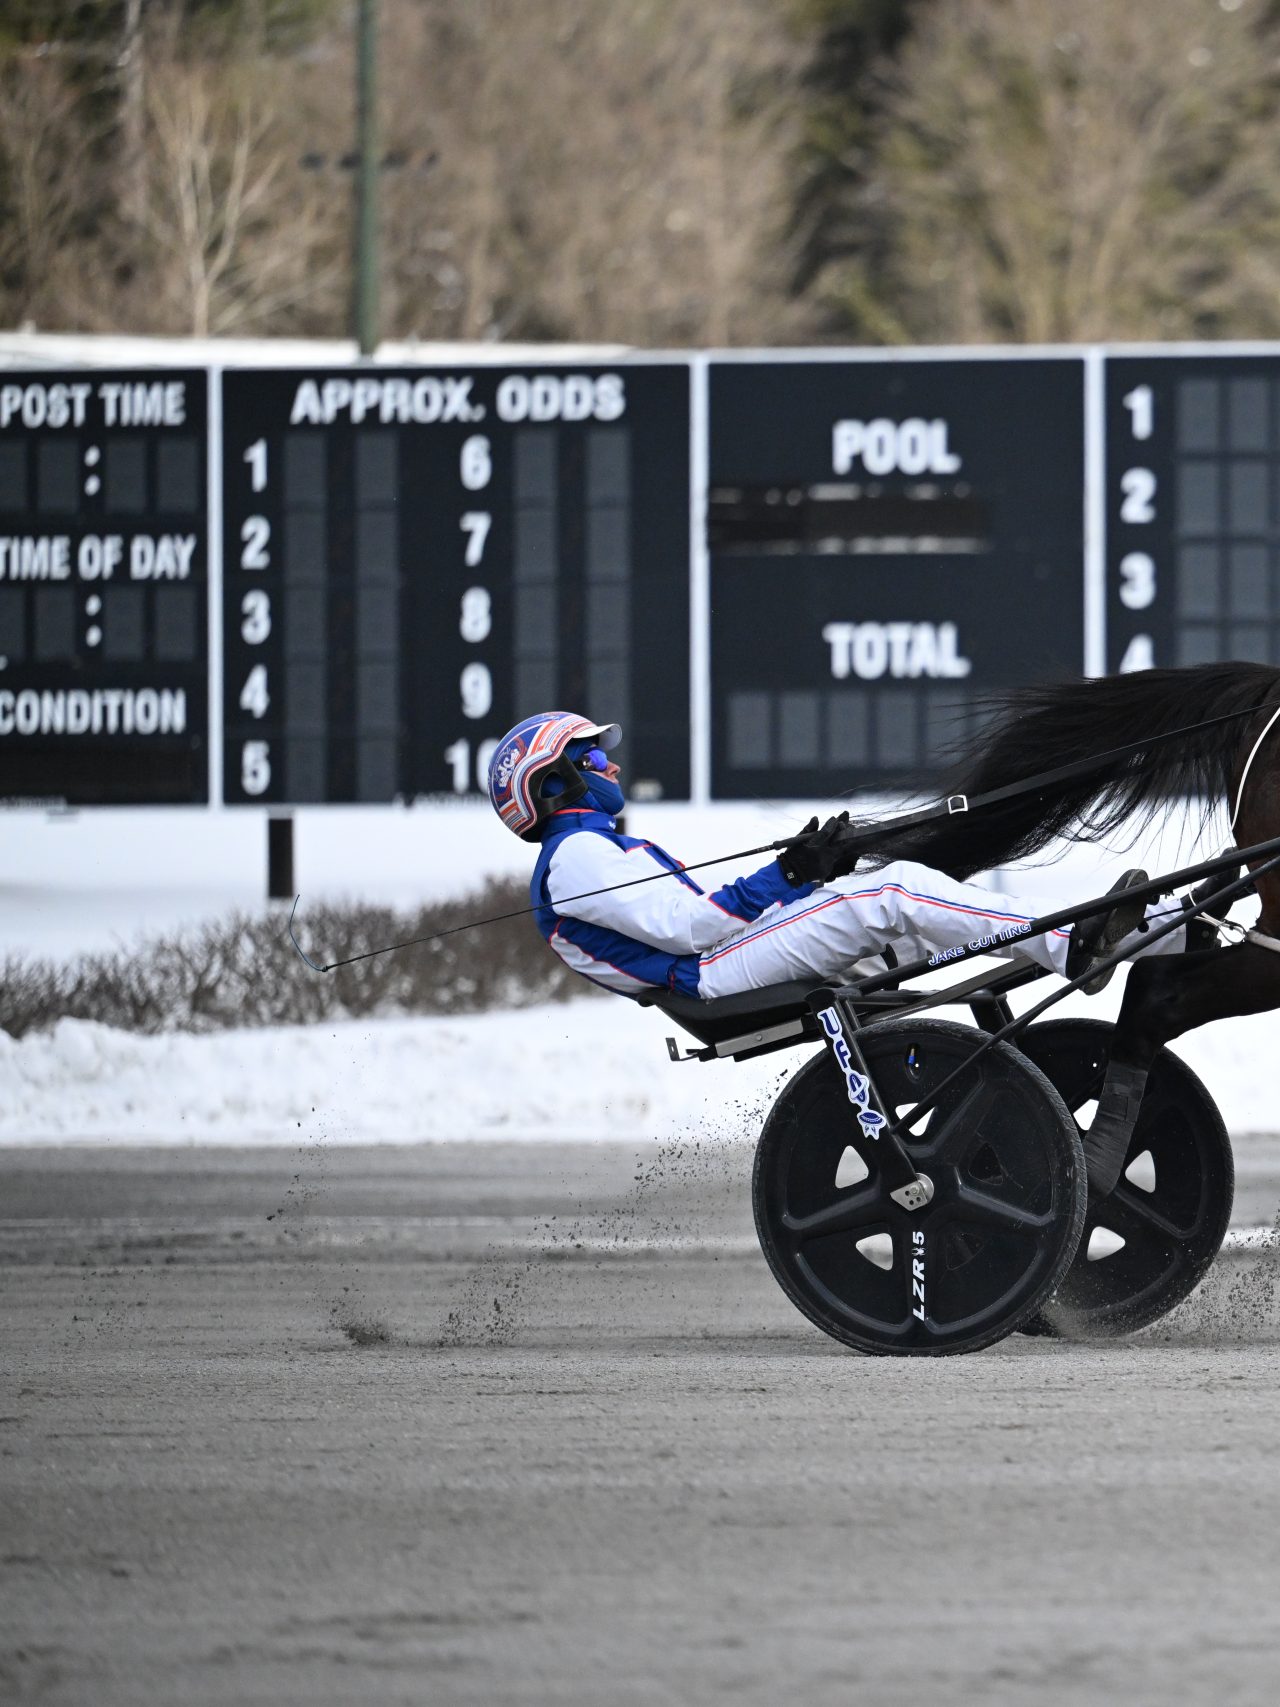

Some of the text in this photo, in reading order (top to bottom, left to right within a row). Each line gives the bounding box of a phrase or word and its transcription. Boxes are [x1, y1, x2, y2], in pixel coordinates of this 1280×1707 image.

[0, 382, 186, 428] POST TIME
[290, 374, 625, 424] APPROX. ODDS
[1123, 386, 1153, 440] 1
[244, 439, 267, 492] 1
[460, 435, 491, 490] 6
[832, 418, 961, 475] POOL
[1120, 467, 1156, 523] 2
[78, 535, 123, 580] OF
[130, 535, 196, 580] DAY
[241, 515, 270, 570] 2
[460, 512, 491, 567] 7
[1120, 552, 1156, 609] 3
[241, 590, 270, 645] 3
[460, 587, 491, 643] 8
[823, 622, 971, 679] TOTAL
[240, 664, 269, 719] 4
[460, 662, 491, 719] 9
[241, 741, 270, 795] 5
[928, 923, 1032, 967] JAKE CUTTING
[912, 1258, 925, 1322] LZR
